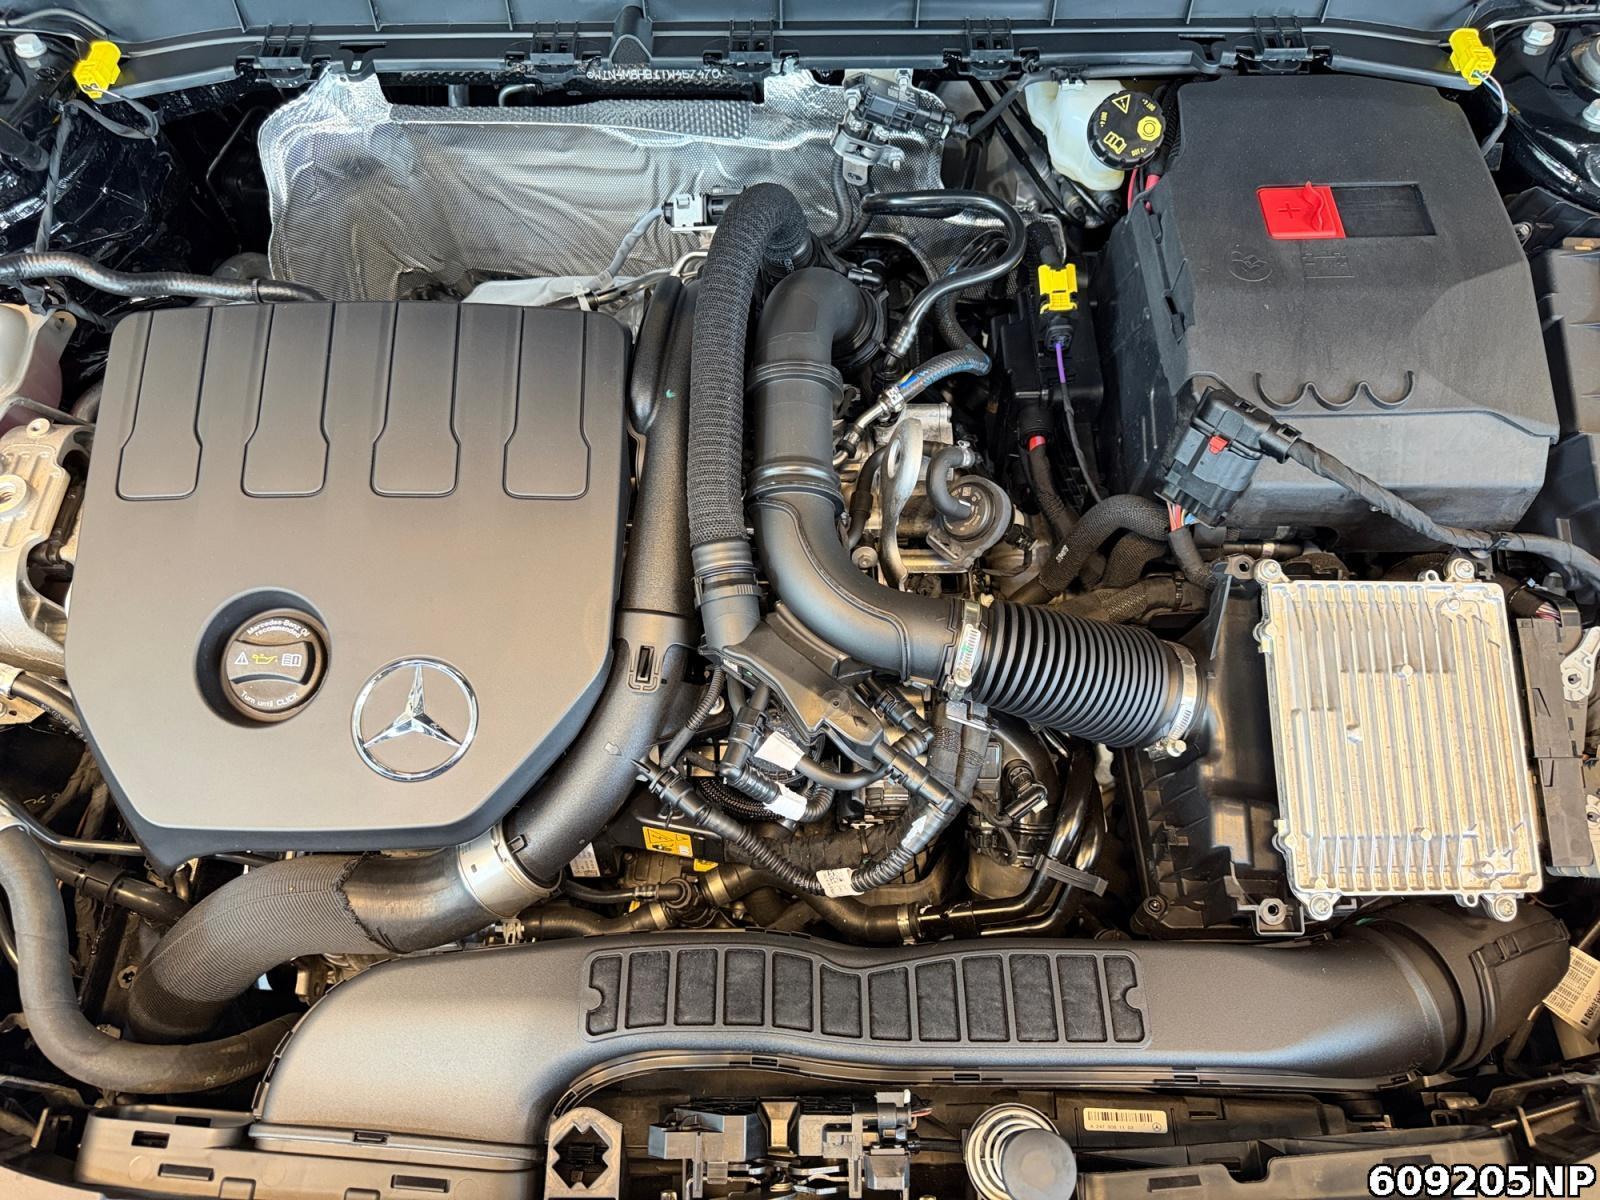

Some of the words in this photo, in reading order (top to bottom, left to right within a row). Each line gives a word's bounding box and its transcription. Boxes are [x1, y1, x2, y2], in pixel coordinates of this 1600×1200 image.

[255, 625, 302, 639] recommended
[241, 690, 256, 705] Turn
[276, 692, 299, 706] CLICK
